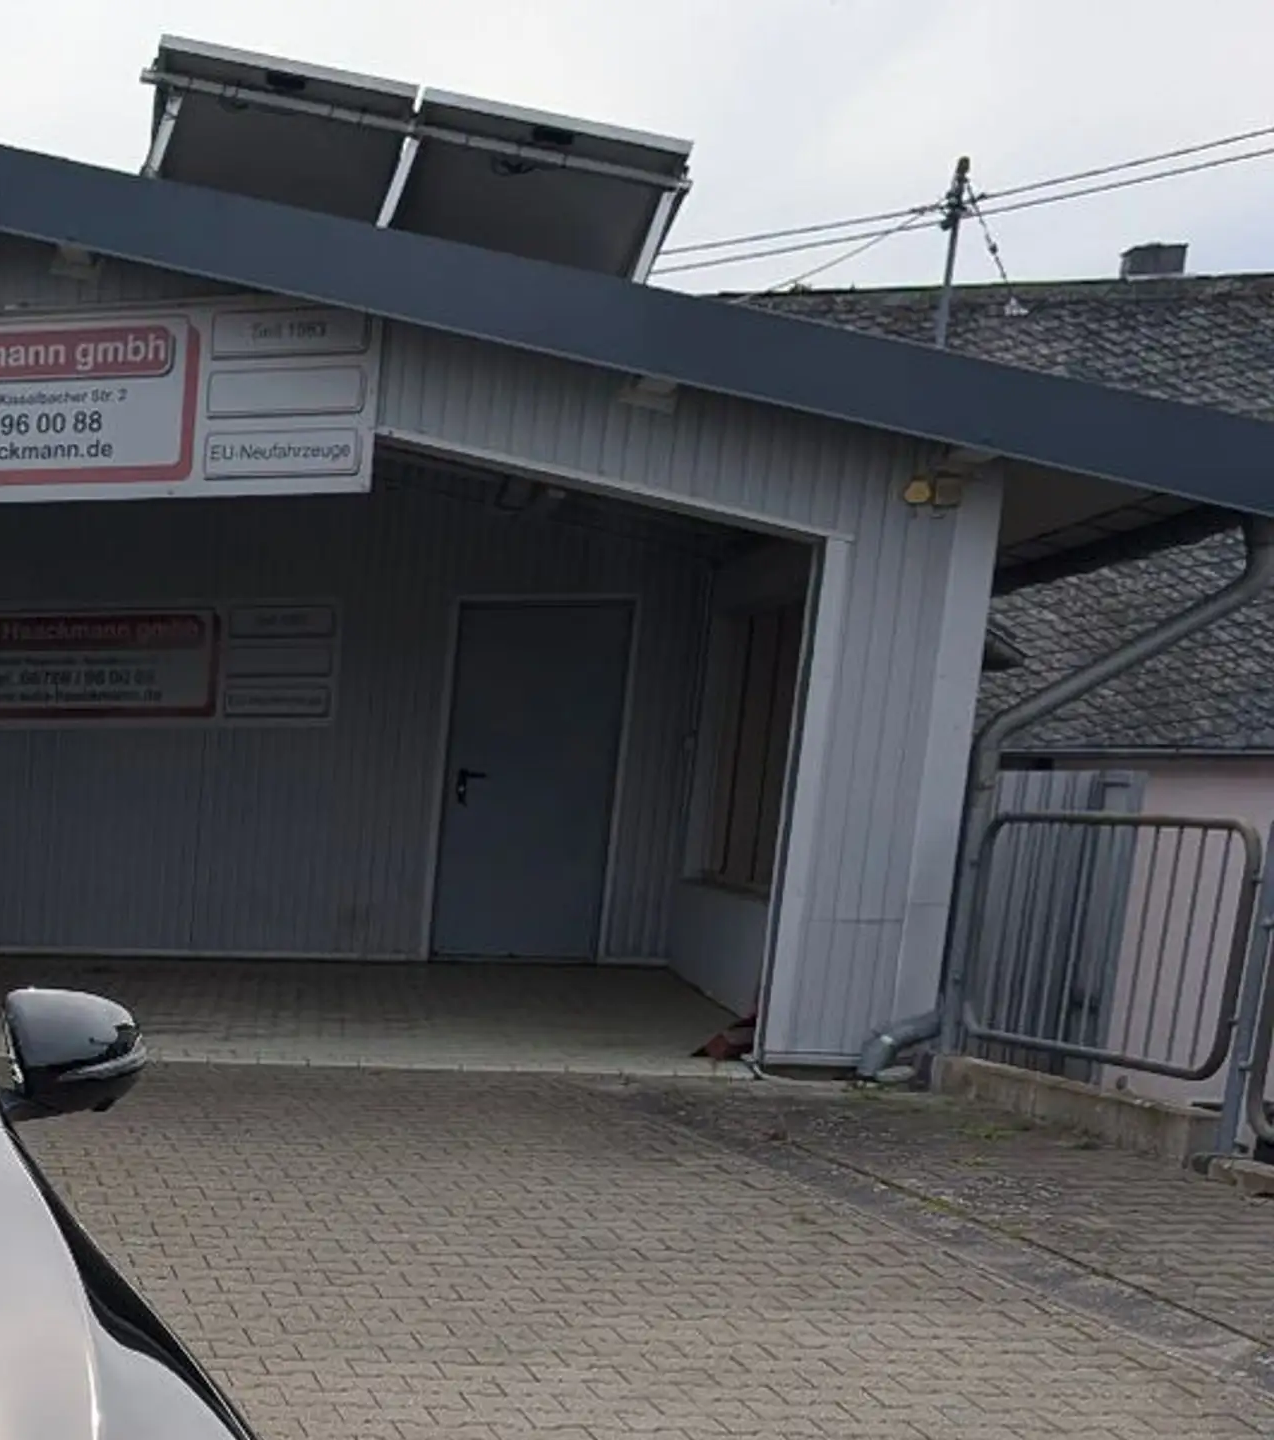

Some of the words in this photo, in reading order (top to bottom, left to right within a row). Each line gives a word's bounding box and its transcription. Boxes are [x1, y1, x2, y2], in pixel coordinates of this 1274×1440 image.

[75, 333, 167, 371] gmbh
[91, 388, 113, 403] Str.
[117, 388, 128, 402] 2
[0, 412, 30, 436] 96
[35, 411, 67, 435] 00
[72, 409, 103, 434] 88
